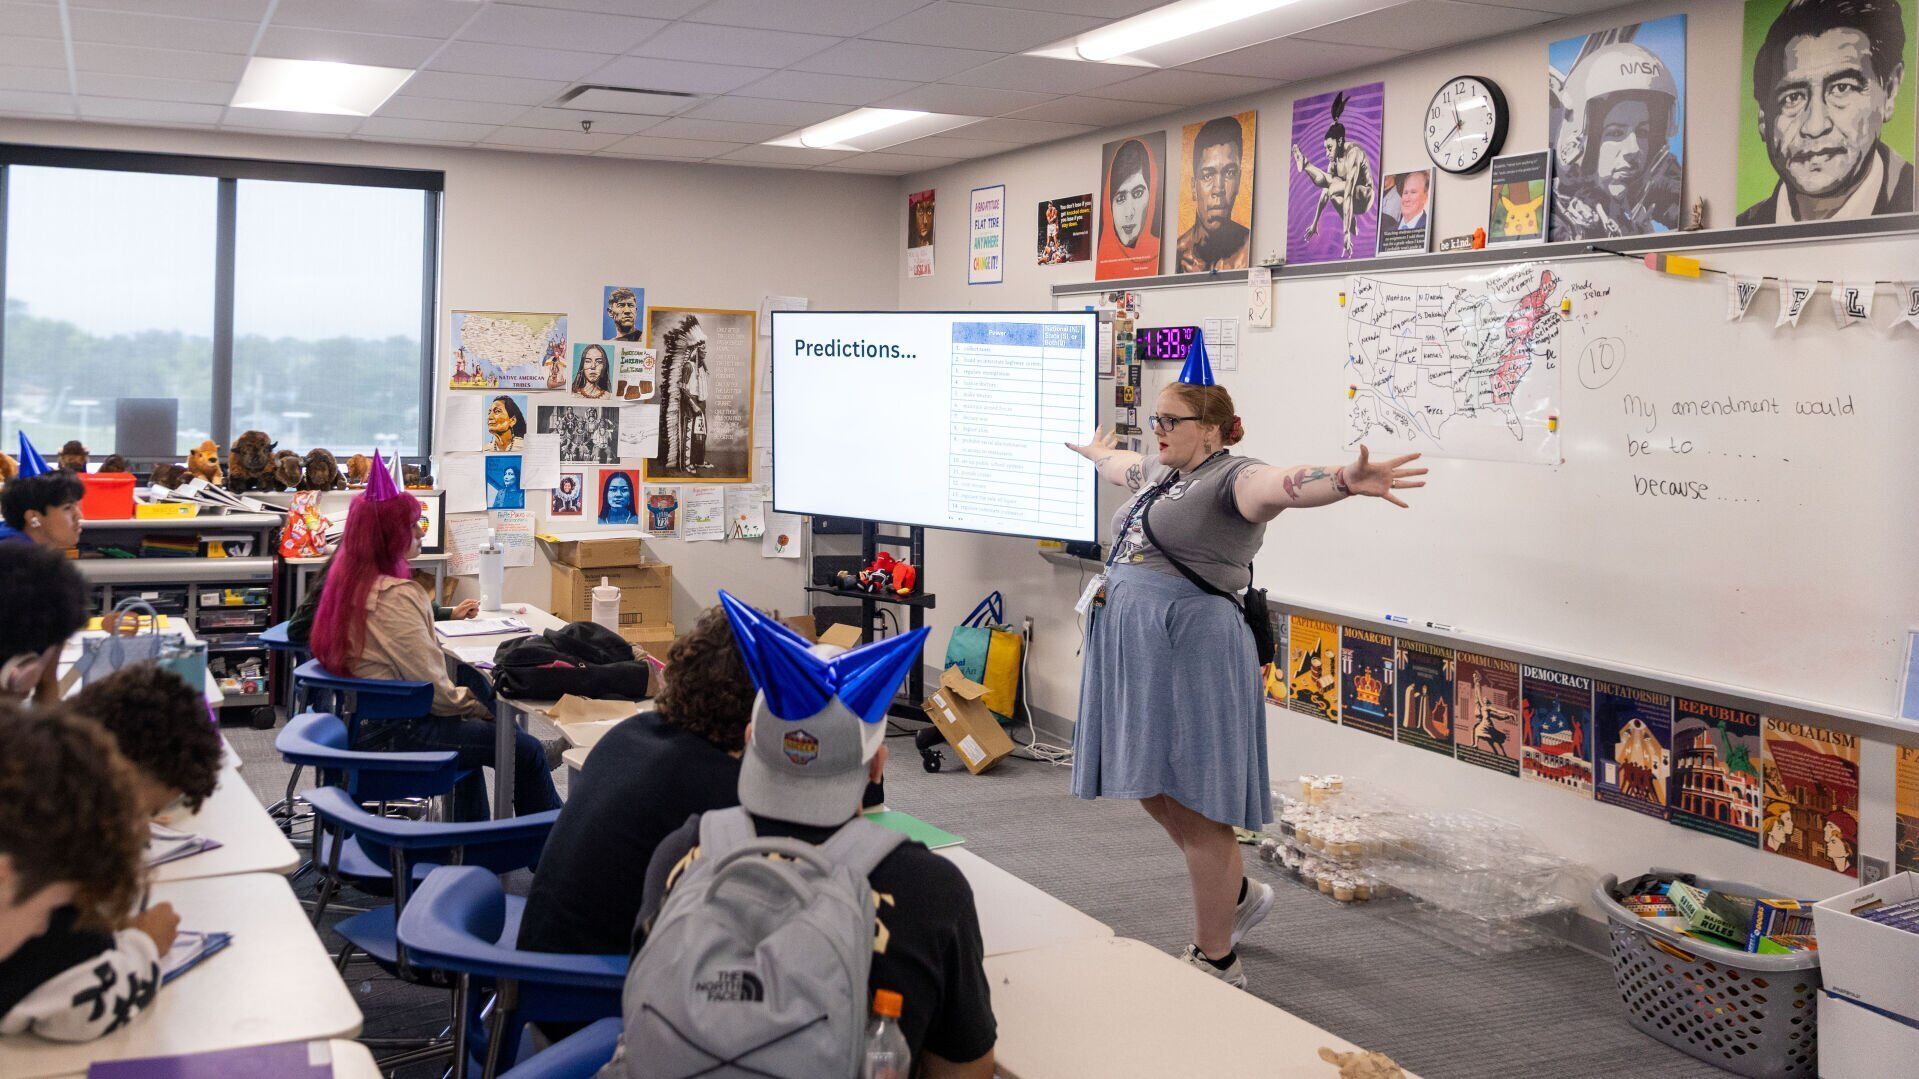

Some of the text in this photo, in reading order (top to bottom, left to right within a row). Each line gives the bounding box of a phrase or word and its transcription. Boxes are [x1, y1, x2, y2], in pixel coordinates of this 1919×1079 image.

[1620, 61, 1663, 80] NASA
[1455, 82, 1465, 95] 12
[1443, 92, 1451, 104] 11
[1431, 107, 1440, 119] 10
[1486, 113, 1492, 125] 3
[1429, 126, 1435, 138] 9
[1482, 132, 1488, 143] 4
[1434, 142, 1439, 153] 8
[1472, 148, 1477, 160] 5
[1445, 153, 1451, 165] 7
[1458, 155, 1464, 167] 6
[975, 217, 1000, 230] FLAT TIRE
[1450, 237, 1471, 249] kind.
[1571, 280, 1592, 292] Rhode
[1737, 282, 1757, 311] W
[1845, 288, 1866, 318] L
[988, 329, 1007, 337] Power
[795, 339, 917, 359] Predictions...
[1589, 343, 1614, 374] 10
[1624, 393, 1855, 433] My amendment would
[1627, 434, 1693, 457] be to
[1291, 615, 1338, 634] CAPITALISM
[1344, 627, 1393, 646] MONARCHY
[1397, 639, 1454, 659] CONSTITUTIONAL
[1457, 651, 1518, 673] COMMUNISM
[1523, 665, 1590, 690] DEMOCRACY
[1596, 681, 1670, 707] DICTATORSHIP
[1679, 698, 1758, 727] REPUBLIC
[1767, 717, 1856, 749] SOCIALISM
[1700, 920, 1735, 937] RULES
[718, 971, 741, 982] THE
[696, 981, 741, 992] NORTH
[708, 990, 741, 1001] FACE
